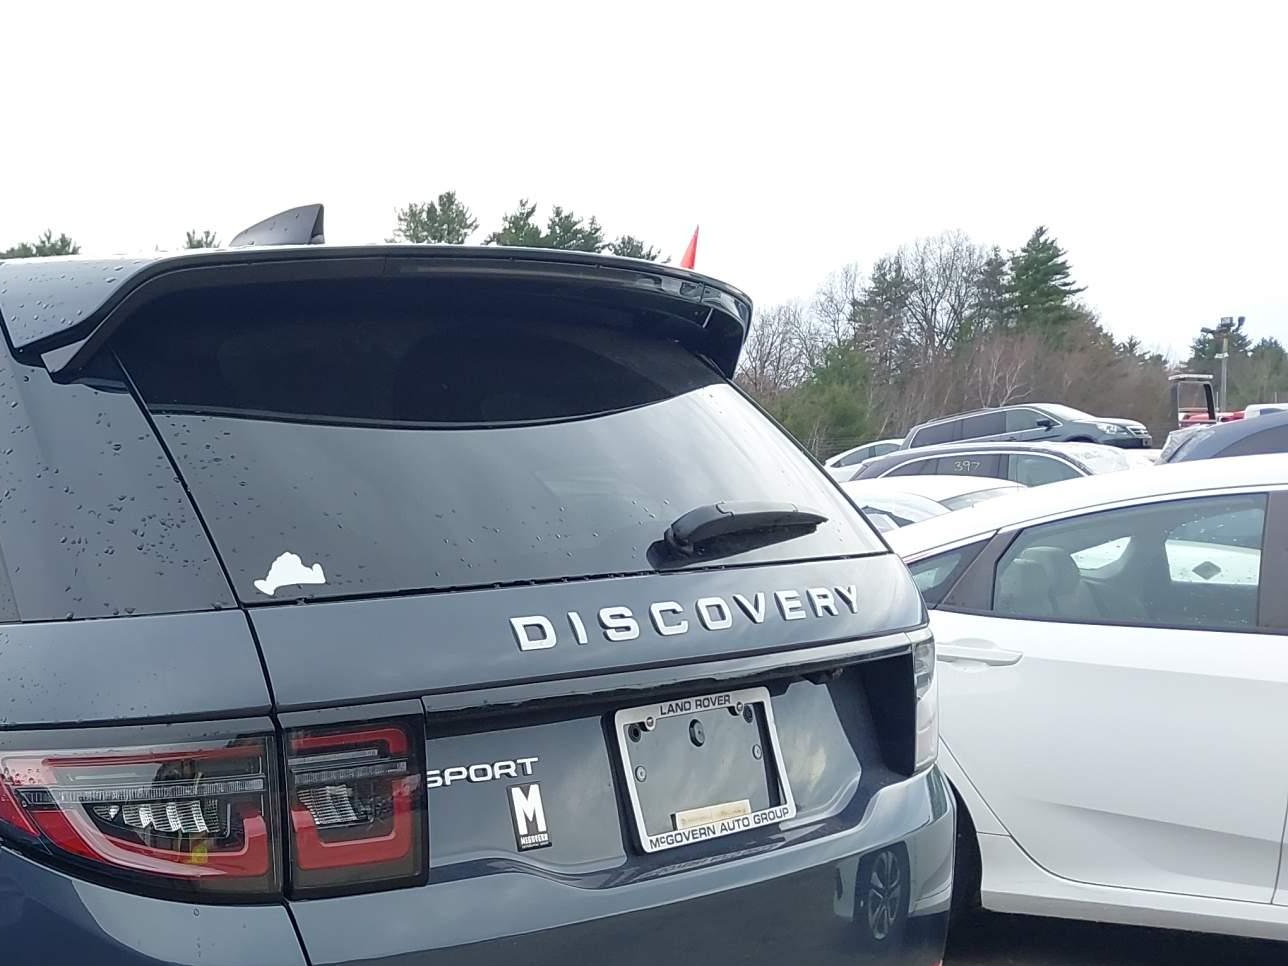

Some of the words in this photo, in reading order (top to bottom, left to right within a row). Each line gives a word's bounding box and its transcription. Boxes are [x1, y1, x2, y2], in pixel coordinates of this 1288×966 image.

[954, 460, 980, 472] 397
[509, 584, 859, 652] DISCOVERY
[659, 700, 692, 716] LAND
[695, 694, 731, 710] ROVER
[426, 757, 539, 788] SPORT
[511, 783, 547, 836] M
[649, 824, 716, 850] McGOVERN
[720, 816, 751, 832] AUTO
[753, 807, 790, 825] GROUP
